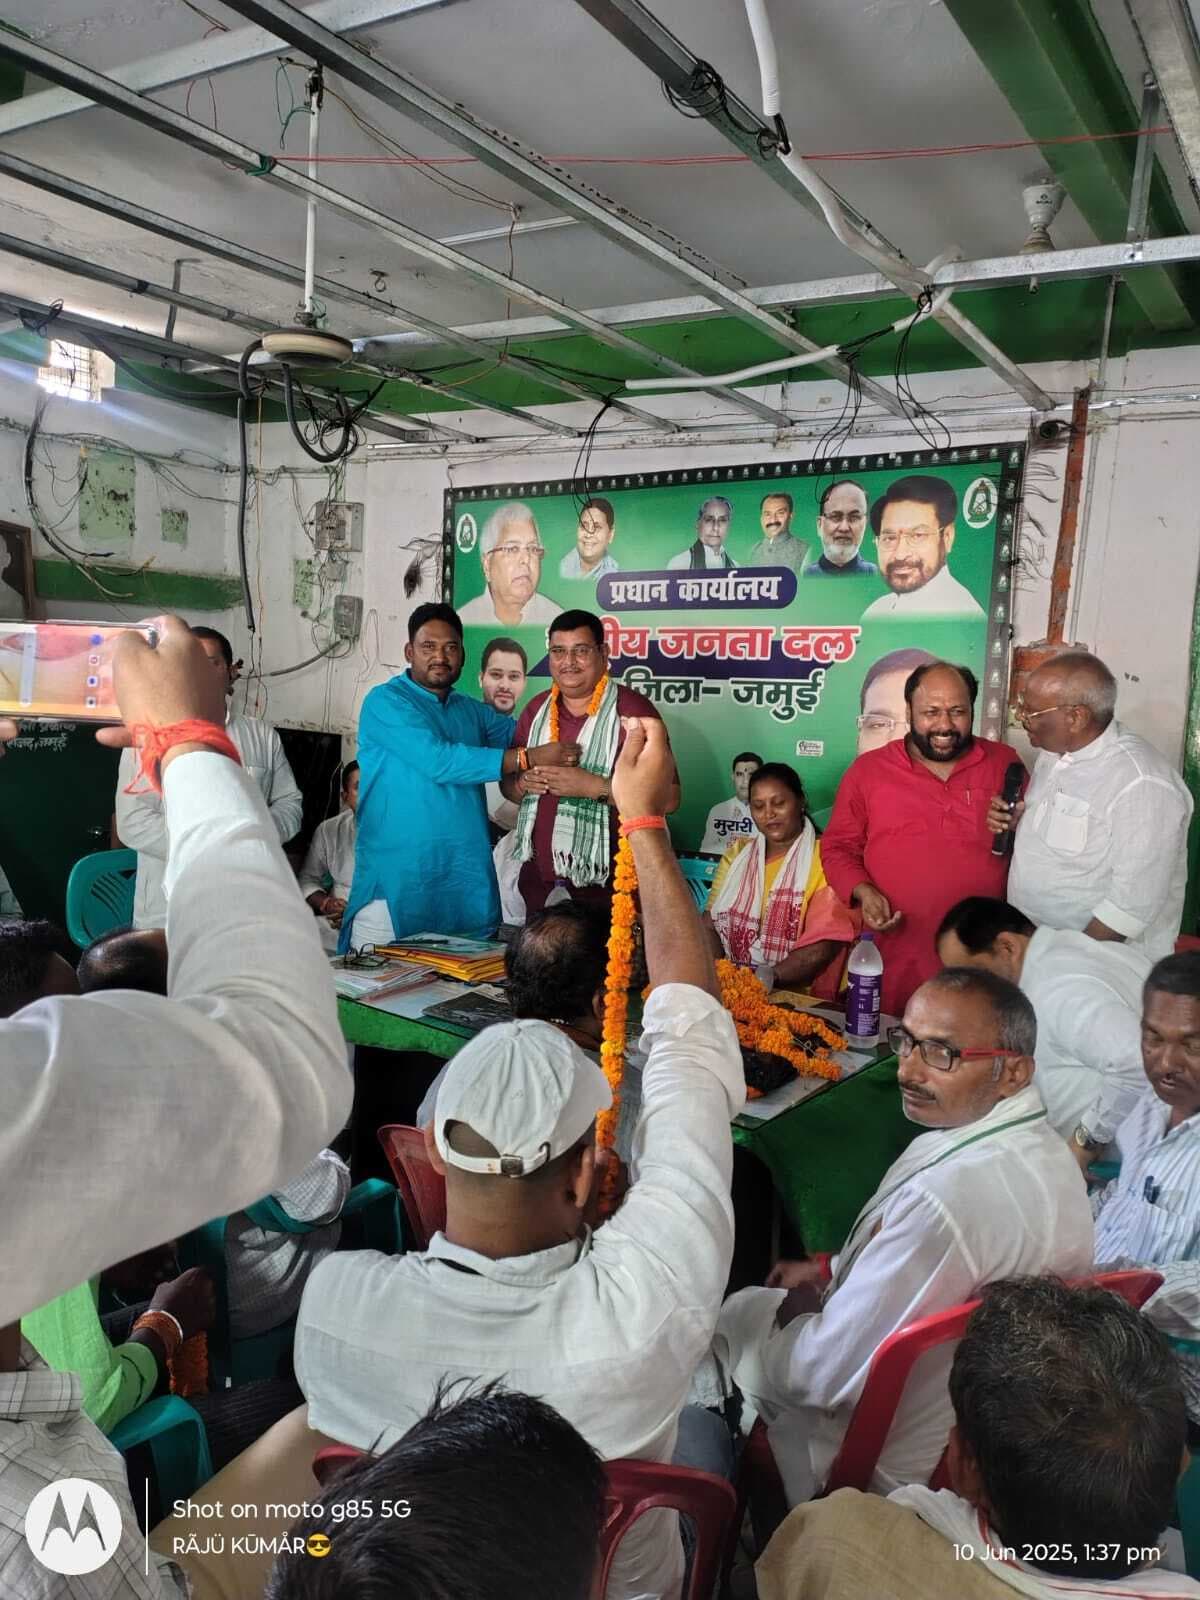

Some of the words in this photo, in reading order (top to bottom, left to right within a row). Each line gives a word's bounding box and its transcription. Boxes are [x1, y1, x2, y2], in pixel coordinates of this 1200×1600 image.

[677, 570, 782, 601] कार्यालय
[657, 626, 774, 660] जनता
[781, 626, 861, 663] दल
[729, 670, 826, 722] जमुई
[713, 817, 753, 836] मुरारी
